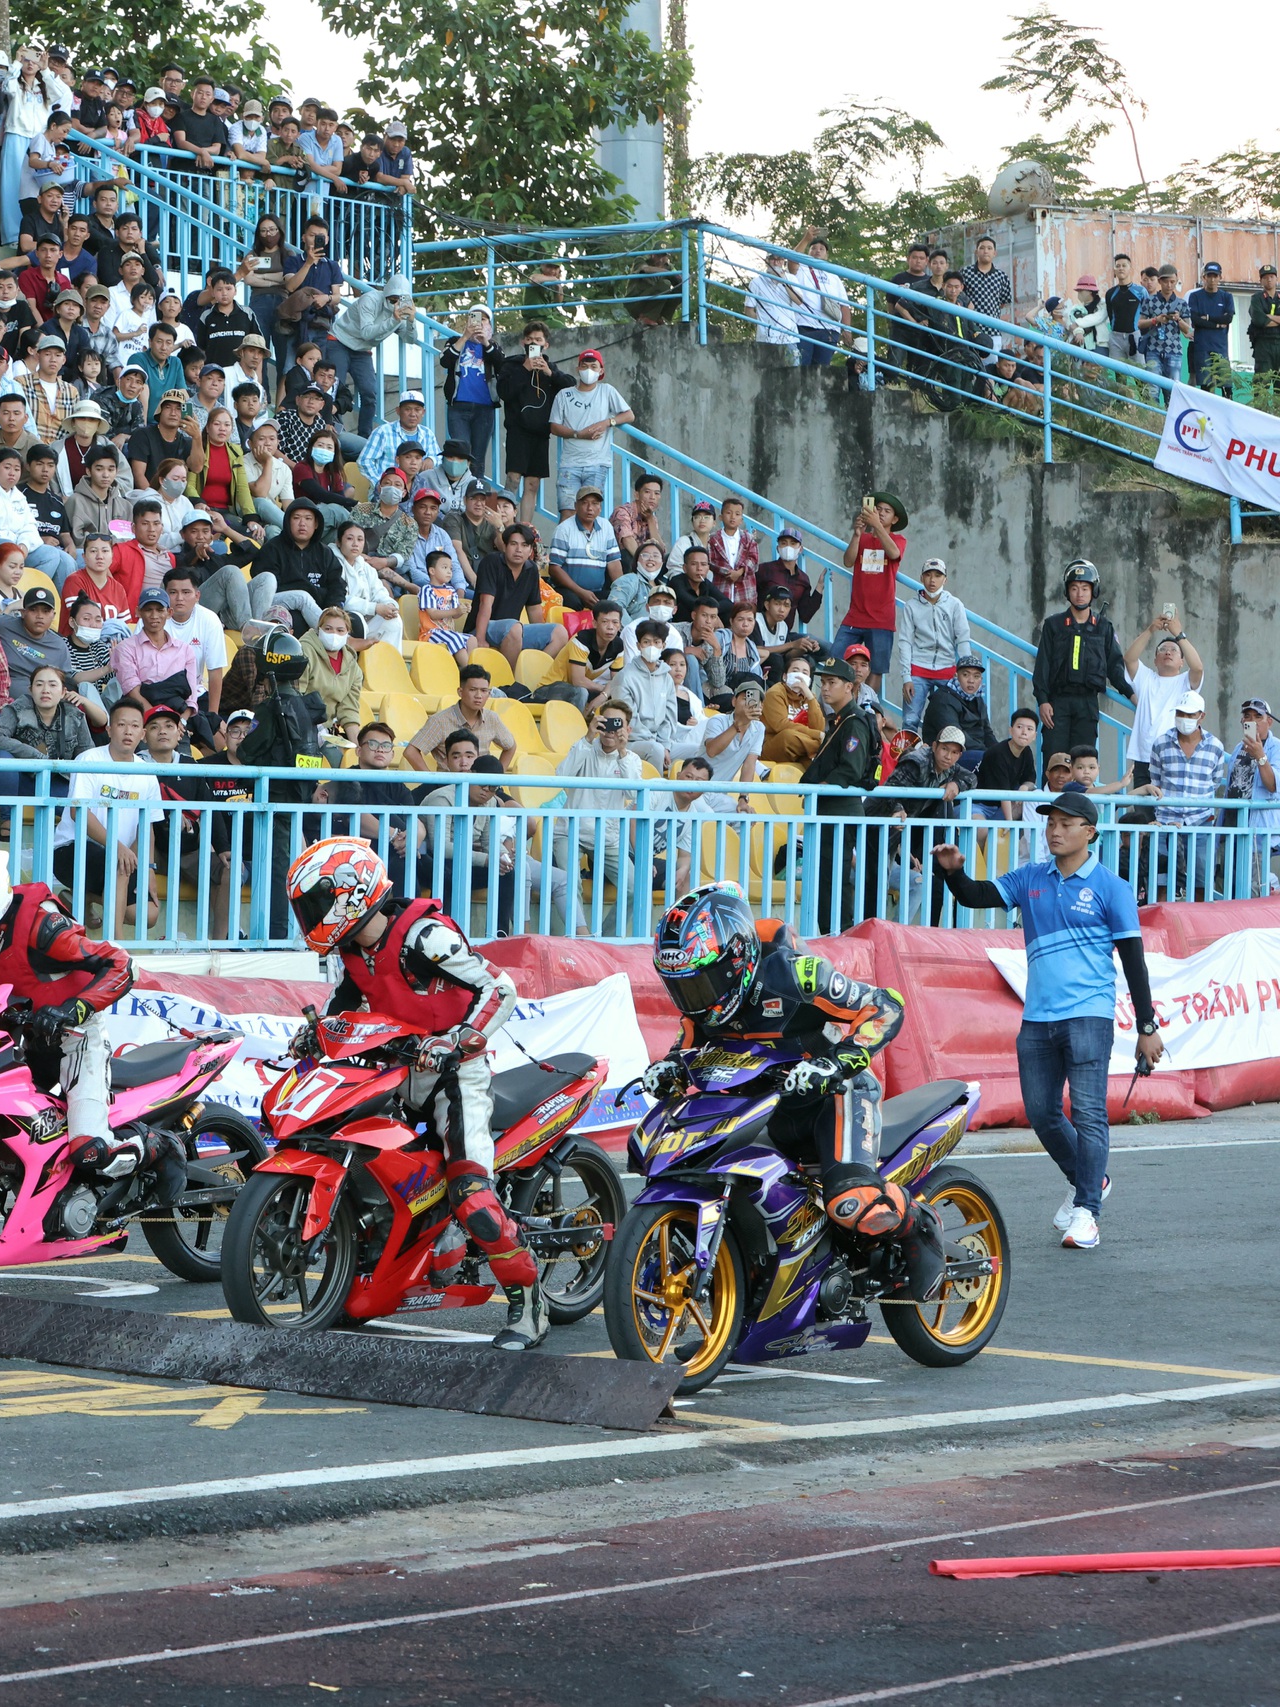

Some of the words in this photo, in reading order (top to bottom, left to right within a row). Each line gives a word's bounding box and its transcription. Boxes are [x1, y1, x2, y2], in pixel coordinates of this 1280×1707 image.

[565, 391, 592, 409] RICH
[1181, 424, 1200, 440] PT
[129, 996, 180, 1023] KỸ
[1172, 979, 1249, 1024] TRÂM
[533, 1093, 569, 1116] RAPIDE
[404, 1293, 446, 1305] RAPIDE
